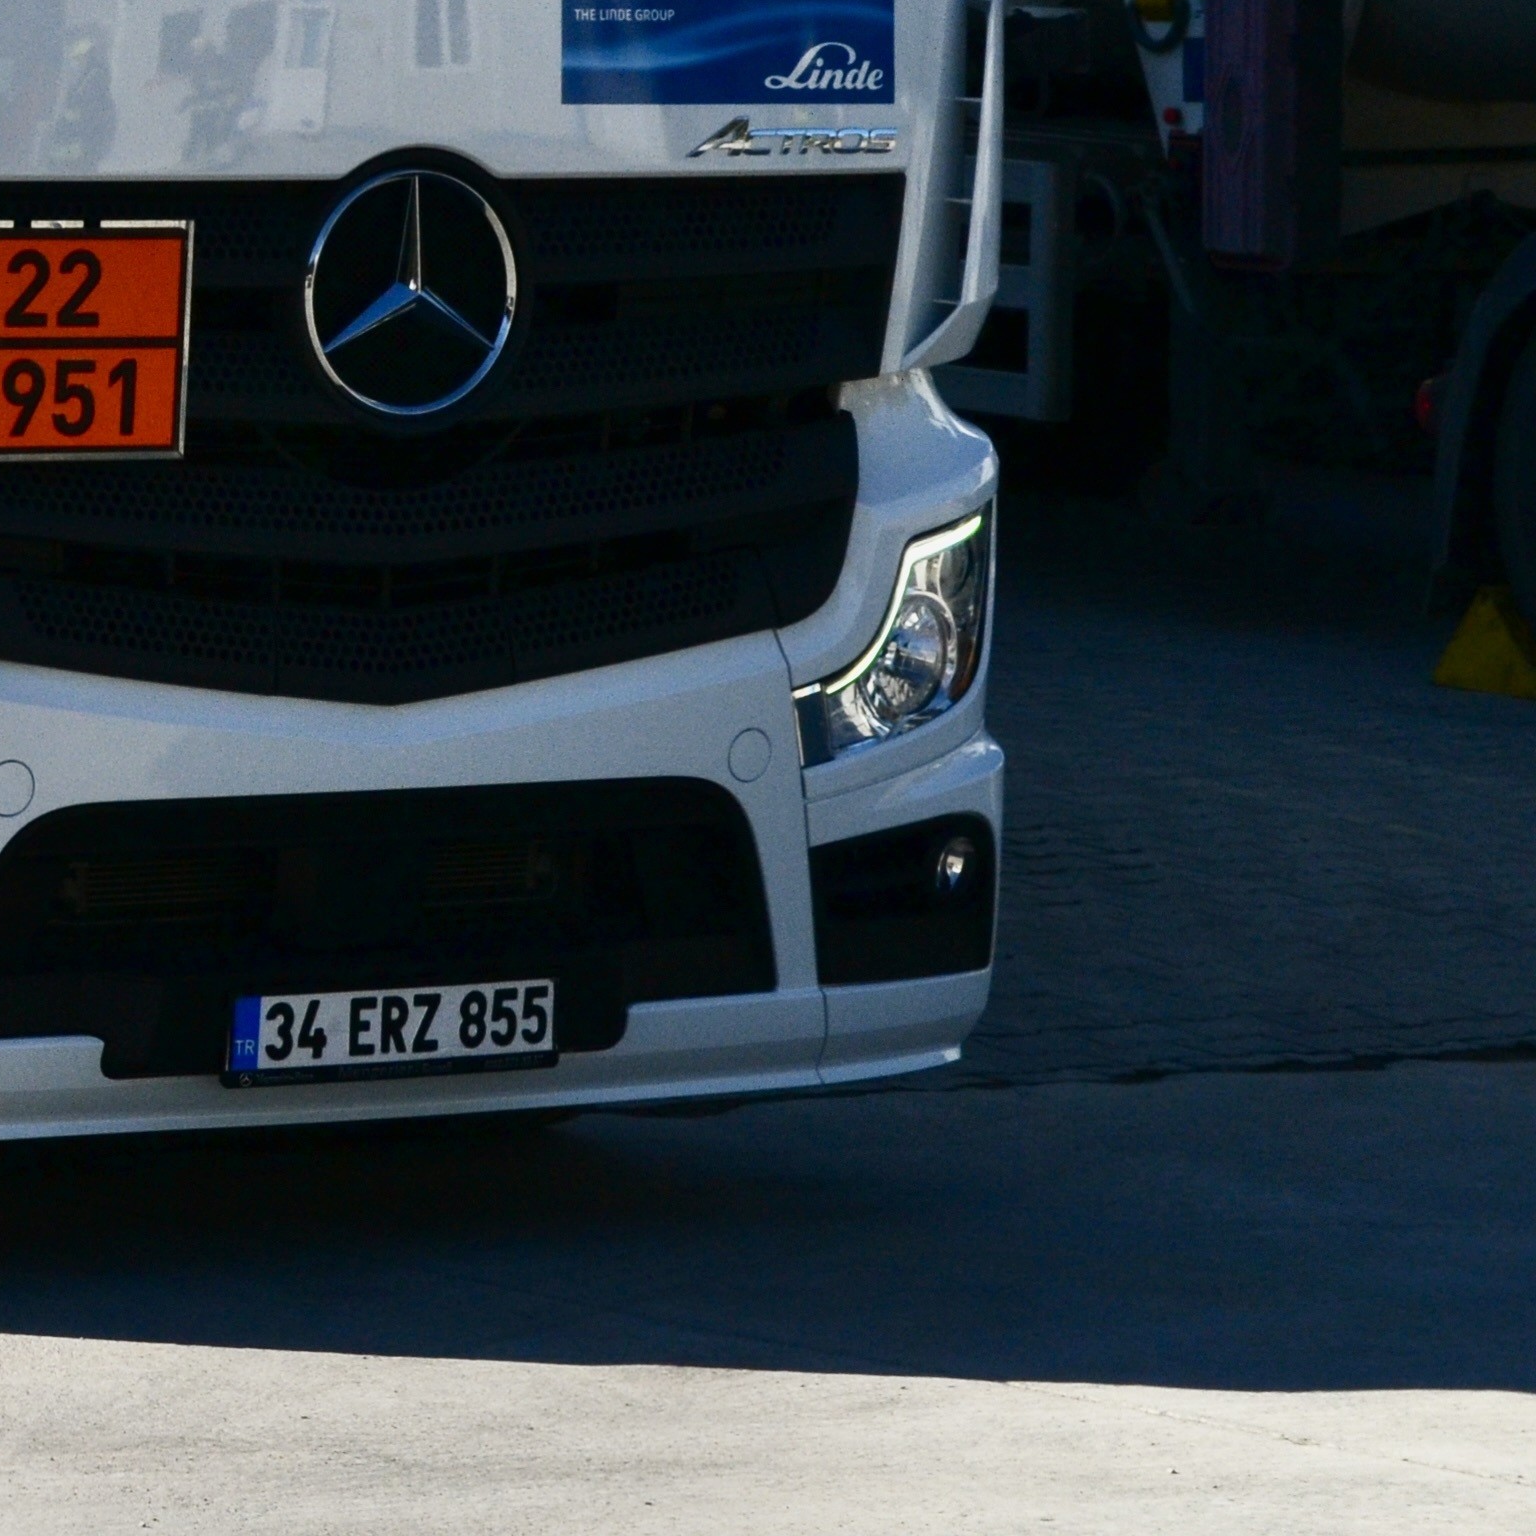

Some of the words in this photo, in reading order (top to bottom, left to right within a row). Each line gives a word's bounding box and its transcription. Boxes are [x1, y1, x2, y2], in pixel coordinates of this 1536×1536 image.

[574, 8, 596, 21] THE
[599, 8, 632, 21] LINDE
[634, 8, 675, 21] GROUP
[764, 41, 884, 91] Linde
[4, 248, 102, 328] 22
[234, 1039, 256, 1055] TR
[265, 999, 328, 1061] 34
[348, 992, 442, 1056] ERZ
[459, 985, 549, 1049] 855
